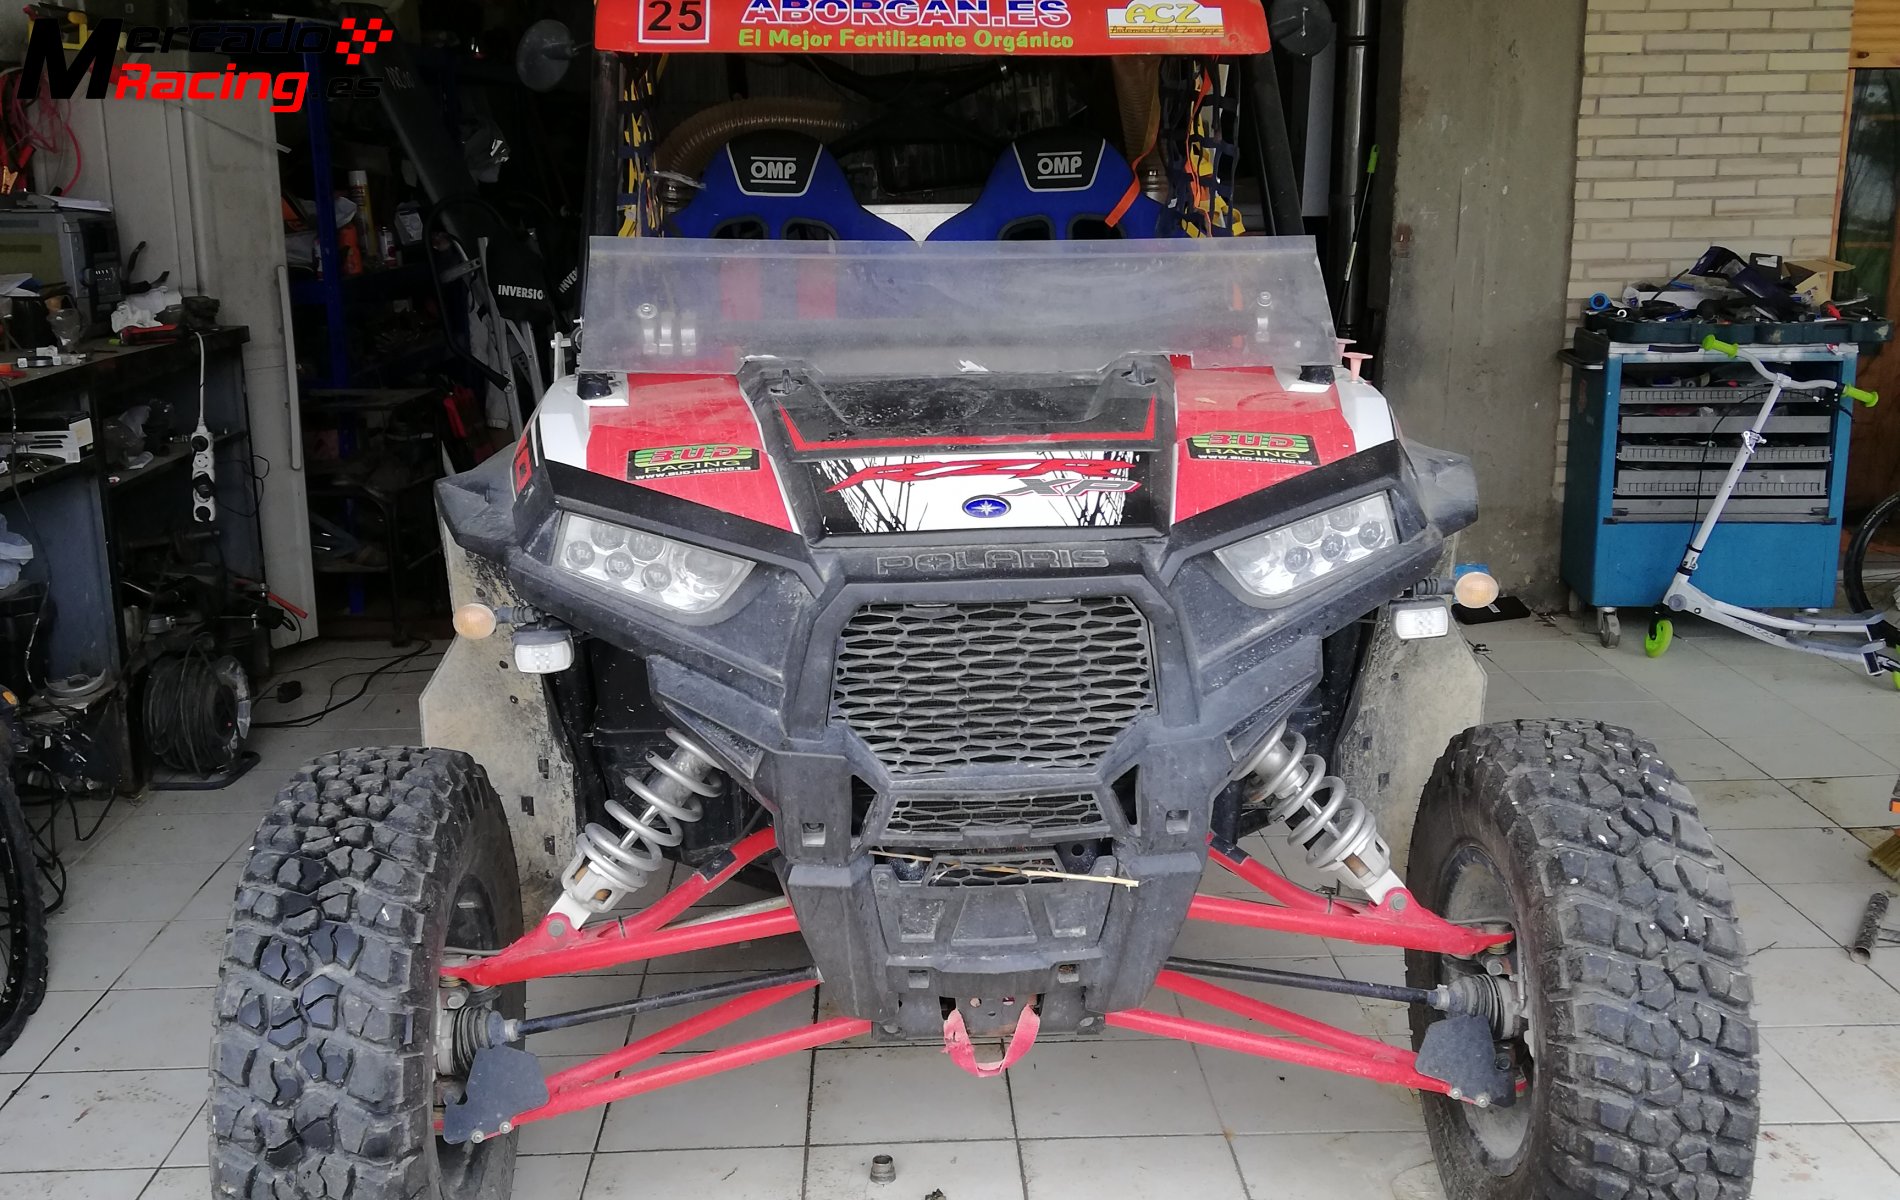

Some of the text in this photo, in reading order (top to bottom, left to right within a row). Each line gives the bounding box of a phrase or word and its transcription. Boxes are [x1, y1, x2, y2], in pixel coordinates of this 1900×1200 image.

[647, 0, 703, 32] 25
[740, 0, 1072, 28] ABORGAN.ES
[1125, 3, 1201, 24] ACZ
[738, 28, 1074, 52] El Mejor Fertilizante Orgánico
[750, 161, 797, 179] OMP
[1037, 155, 1082, 175] OMP
[558, 266, 578, 293] INVE
[498, 284, 546, 300] INVERSIO
[1208, 433, 1296, 449] BUD
[649, 446, 740, 464] BUD
[1205, 448, 1300, 459] RACING
[644, 460, 740, 474] RACING
[998, 478, 1142, 496] XP
[876, 549, 1109, 575] POLARIS
